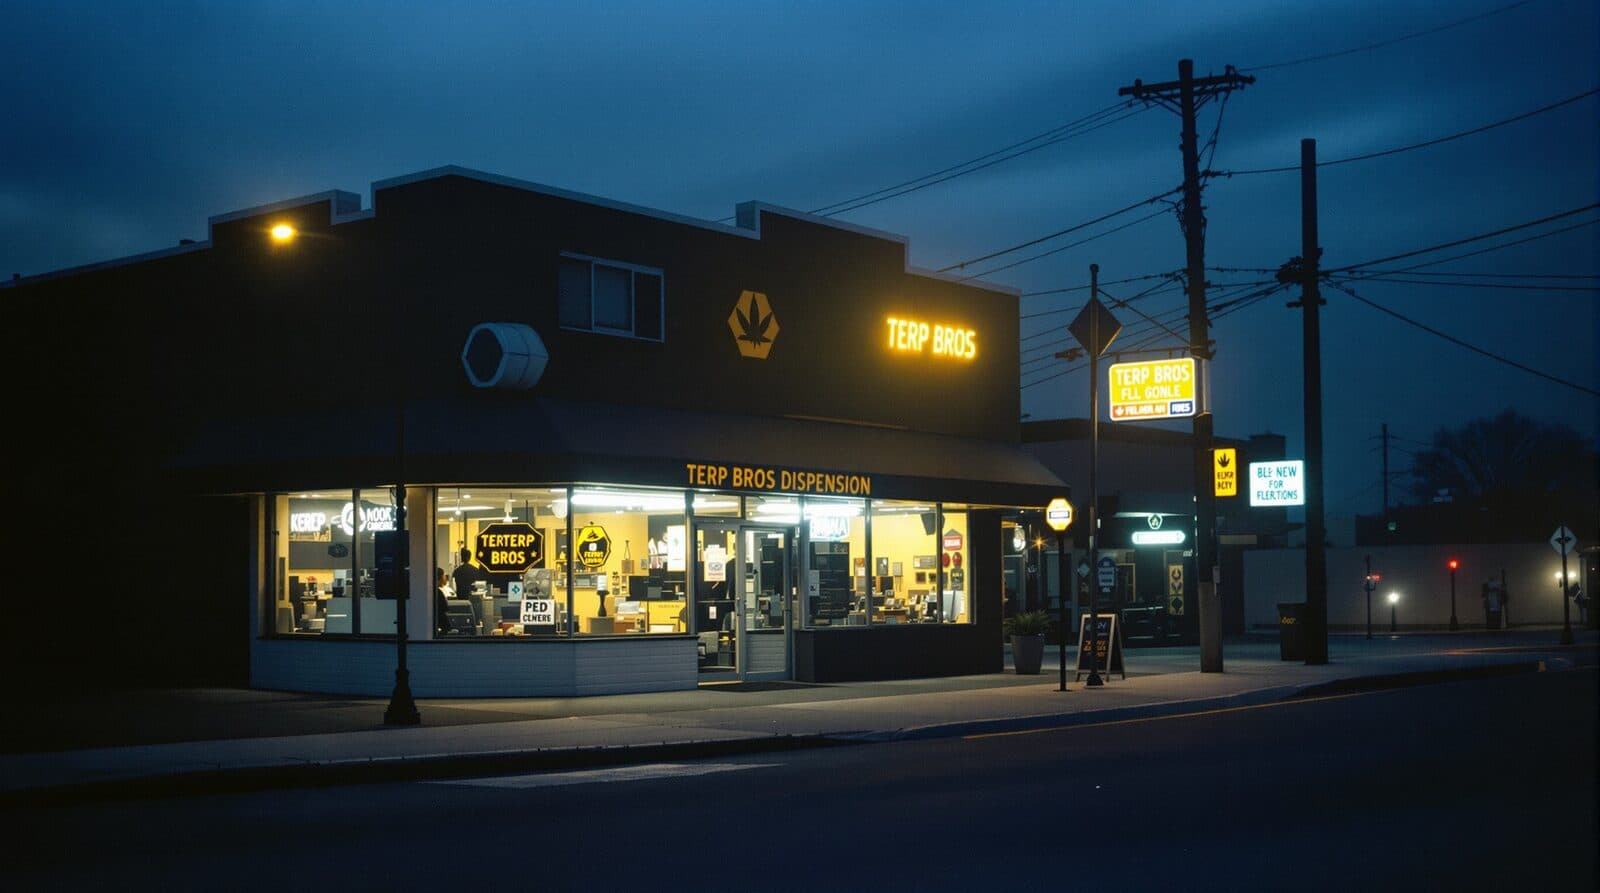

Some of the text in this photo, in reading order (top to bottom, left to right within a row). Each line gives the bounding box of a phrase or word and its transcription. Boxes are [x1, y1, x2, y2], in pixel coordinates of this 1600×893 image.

[887, 317, 976, 359] TERP BROS
[1116, 363, 1190, 385] TERP BROS
[1276, 466, 1297, 478] NEW
[687, 463, 871, 495] TERP BROS DISPENSION
[1268, 480, 1284, 489] FOR
[481, 534, 534, 547] TERTERP
[491, 551, 526, 565] BROS
[525, 602, 548, 612] PED
